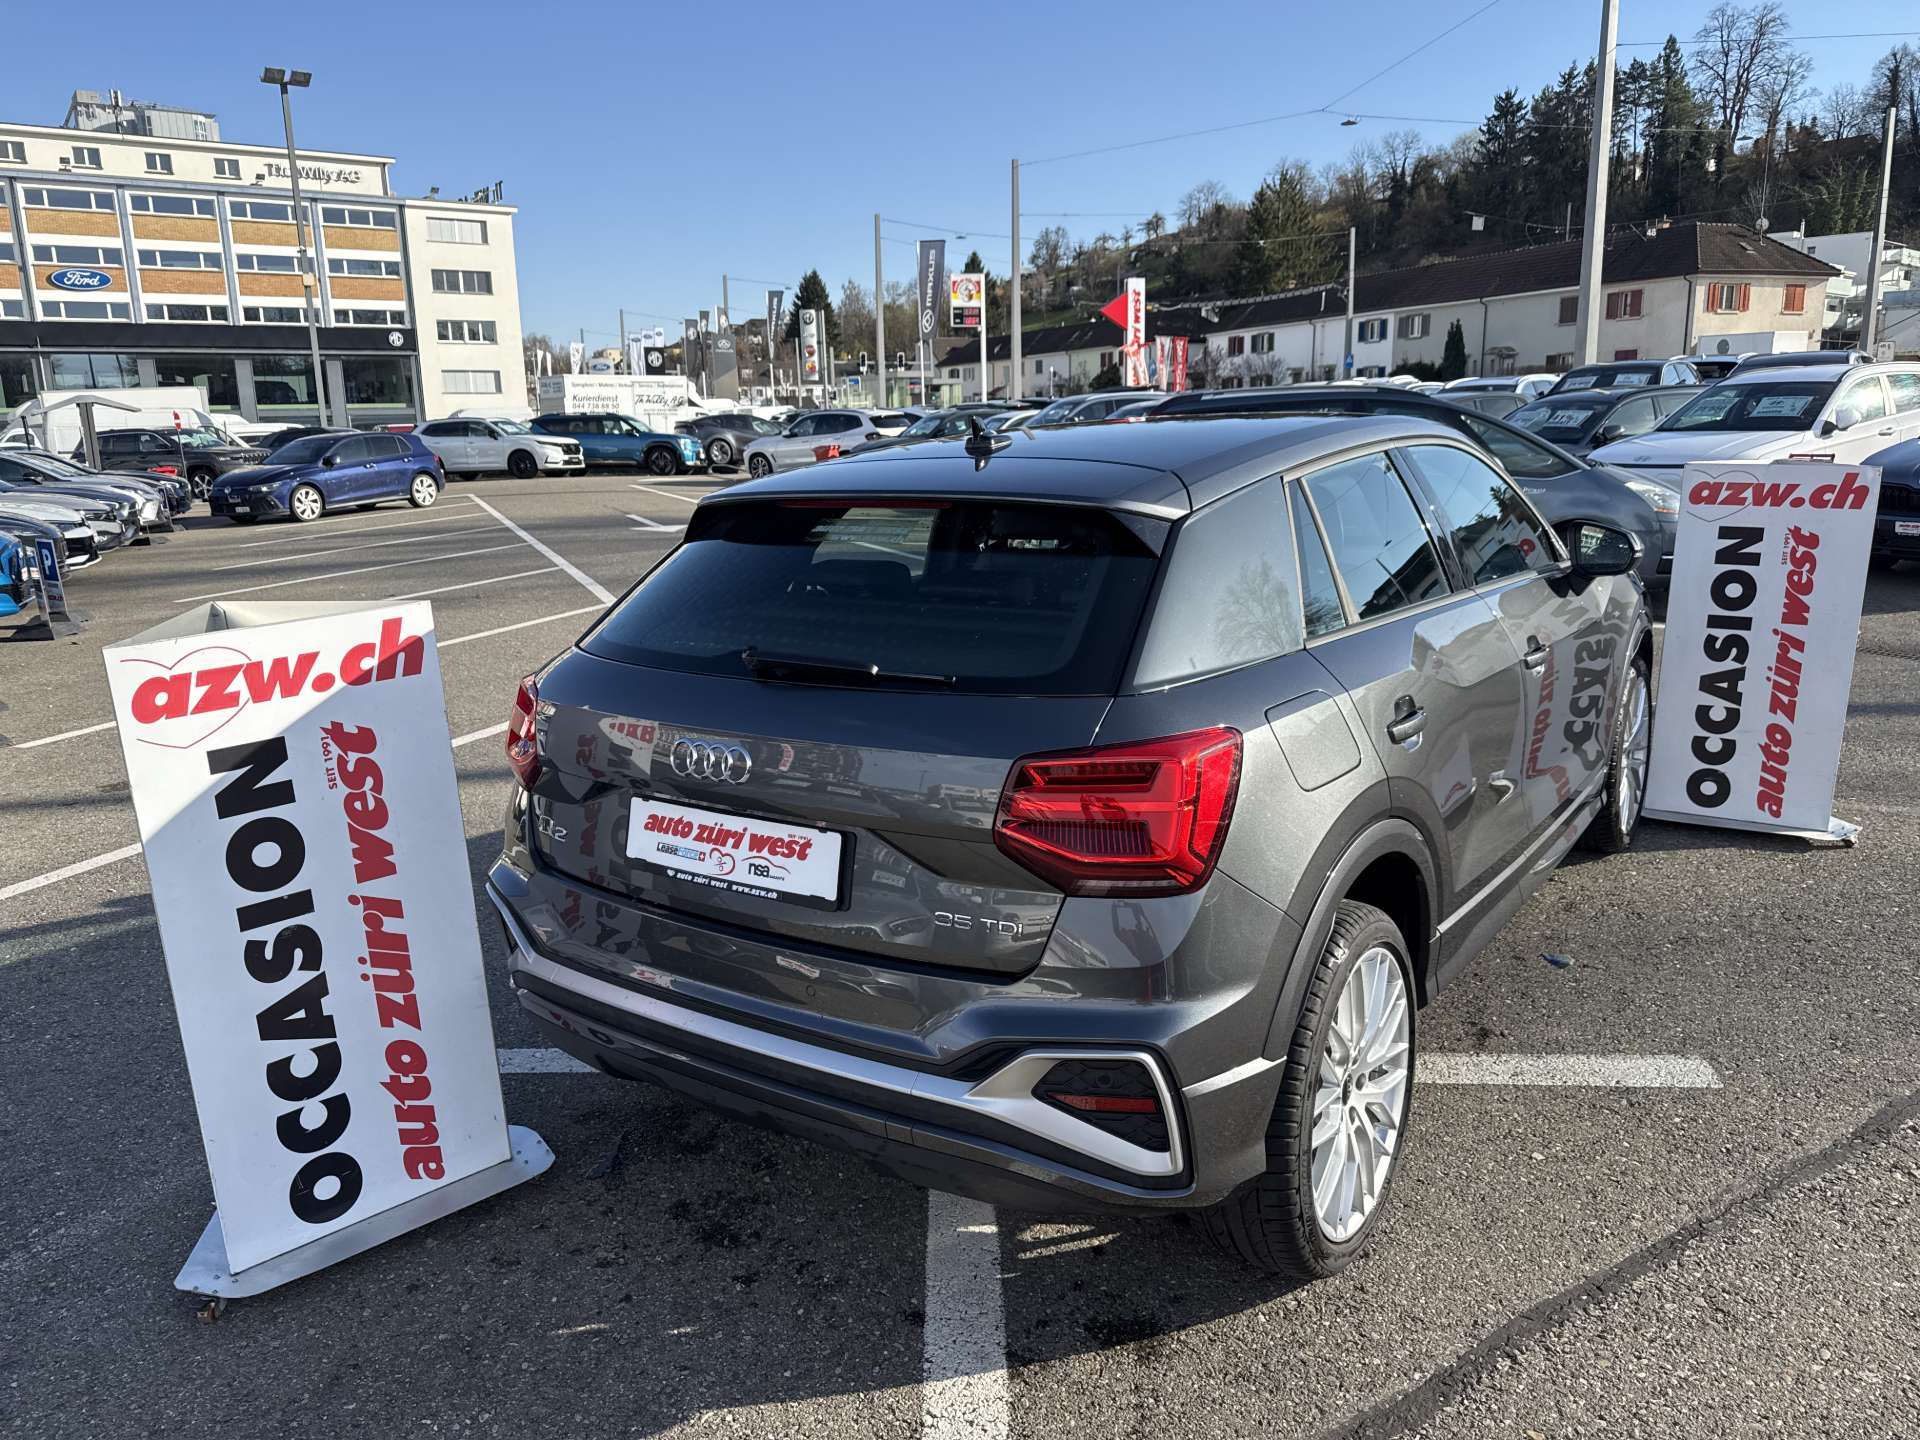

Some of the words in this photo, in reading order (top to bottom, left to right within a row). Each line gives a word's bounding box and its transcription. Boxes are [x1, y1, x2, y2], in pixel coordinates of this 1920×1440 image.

[63, 271, 101, 286] Ford
[572, 394, 618, 402] Kurierdienst
[1688, 472, 1870, 510] azw.ch
[41, 549, 51, 575] P
[1780, 525, 1820, 626] west
[131, 617, 425, 725] azw.ch
[1686, 525, 1765, 809] OCCASION
[1765, 628, 1806, 725] züri
[321, 736, 333, 764] 1991
[1756, 722, 1792, 818] auto
[320, 720, 397, 884] west
[328, 768, 338, 790] SEIT
[643, 813, 694, 838] auto
[692, 821, 748, 850] züri
[749, 832, 813, 861] west
[676, 872, 693, 881] auto
[710, 880, 728, 889] west
[748, 862, 770, 878] nsa
[934, 911, 972, 930] 35
[980, 918, 1023, 937] TDI
[206, 735, 363, 1224] OCCASION
[347, 895, 422, 1031] züri
[379, 1039, 445, 1181] auto
